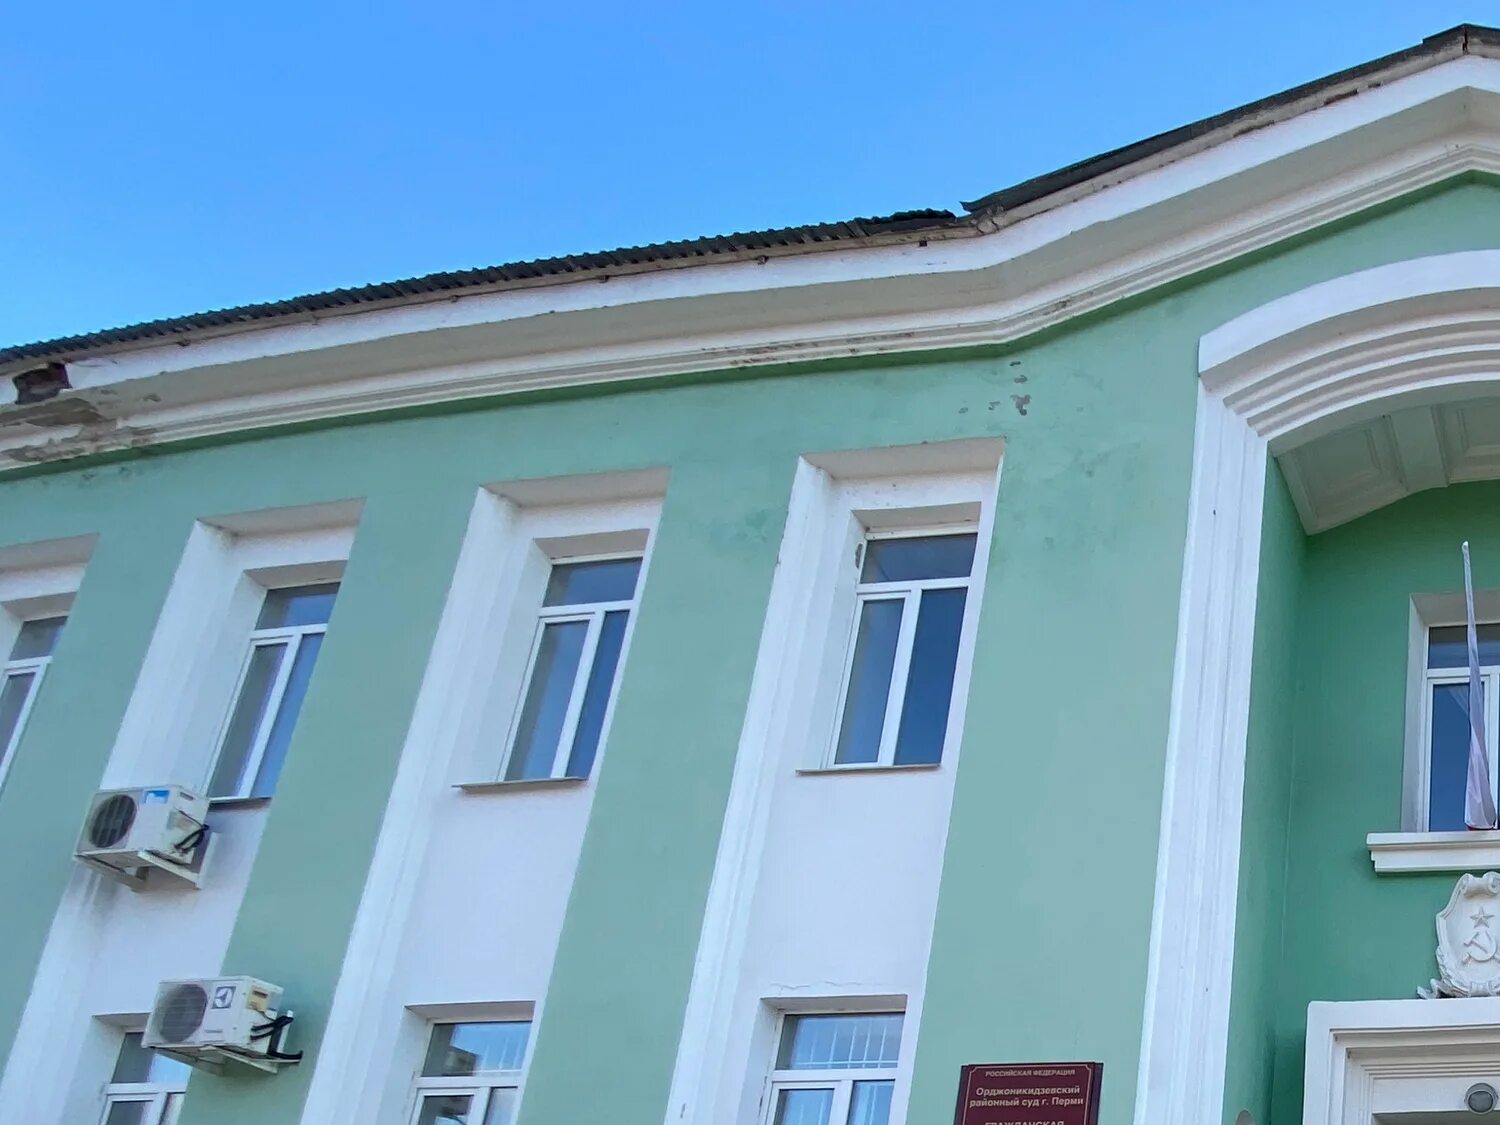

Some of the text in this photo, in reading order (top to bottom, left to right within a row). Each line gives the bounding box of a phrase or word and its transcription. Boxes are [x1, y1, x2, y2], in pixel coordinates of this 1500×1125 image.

[976, 1086, 1080, 1097] Орджоникидзевский
[969, 1097, 1084, 1108] районный суд г. Перми
